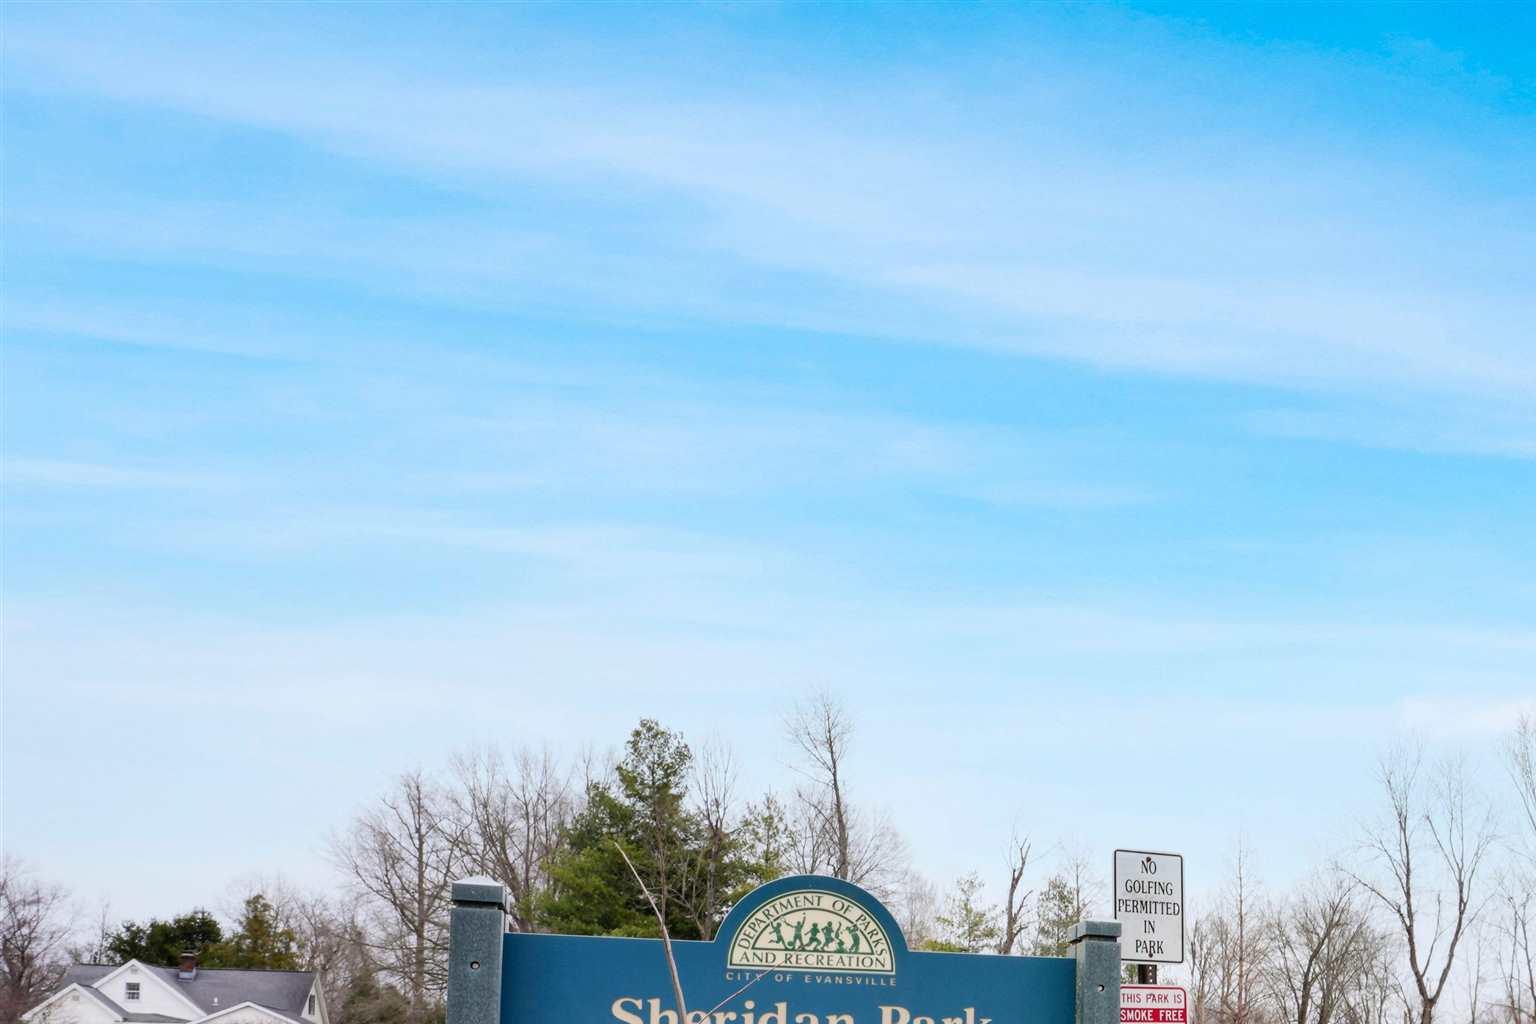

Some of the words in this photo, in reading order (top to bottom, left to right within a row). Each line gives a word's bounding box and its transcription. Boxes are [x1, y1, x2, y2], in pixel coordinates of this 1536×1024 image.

[1141, 860, 1157, 875] NO
[1125, 879, 1173, 896] GOLFING
[1118, 899, 1180, 916] PERMITTED
[737, 895, 824, 950] DEPARTMENT
[832, 901, 852, 919] OF
[855, 913, 888, 957] PARKS
[1144, 920, 1155, 934] IN
[1135, 939, 1164, 954] PARK
[739, 953, 776, 965] AND
[784, 953, 886, 968] RECREATION
[725, 972, 762, 981] CITY
[775, 974, 793, 983] OF
[804, 975, 897, 986] EVANSVILLE
[1122, 993, 1141, 1003] THIS
[1146, 993, 1169, 1004] PARK
[1174, 994, 1182, 1004] IS
[1120, 1009, 1153, 1021] SMOKE
[1160, 1010, 1184, 1021] FREE
